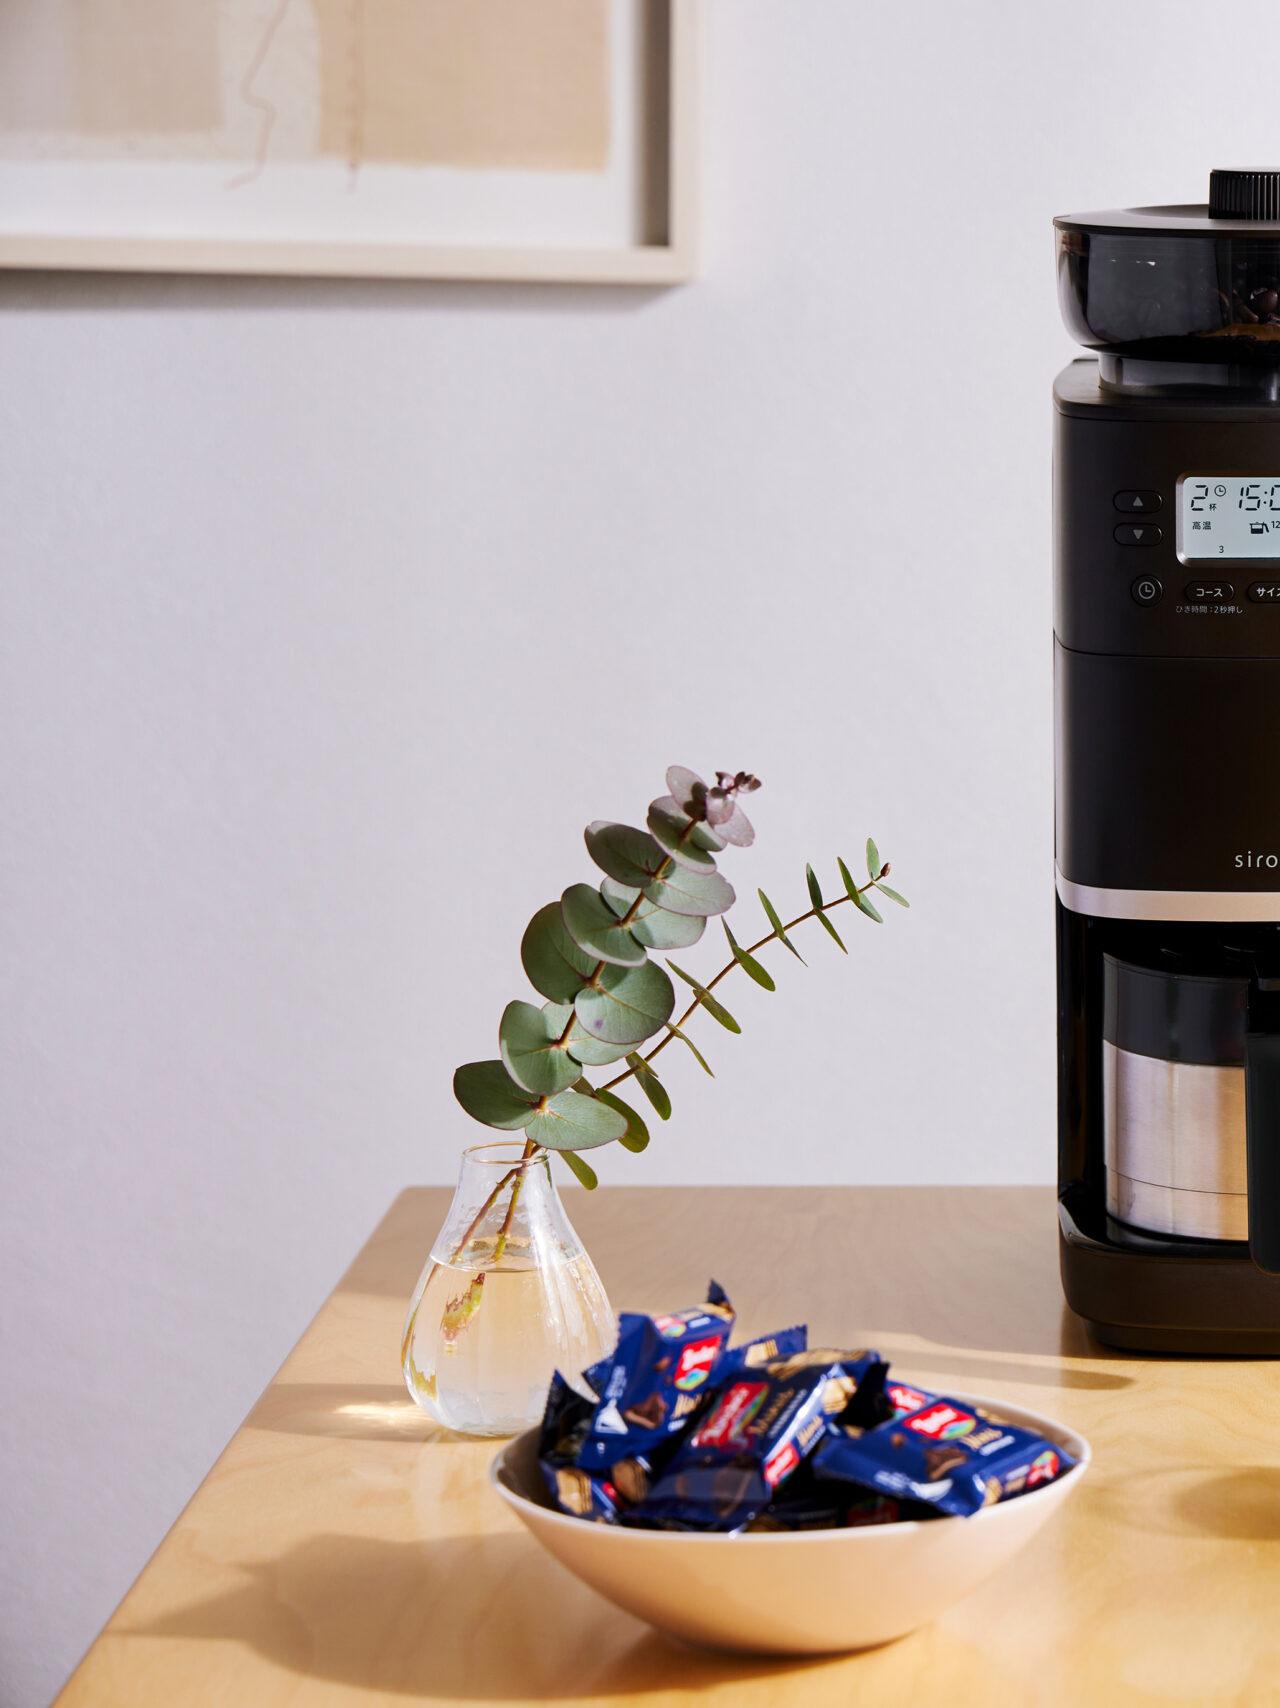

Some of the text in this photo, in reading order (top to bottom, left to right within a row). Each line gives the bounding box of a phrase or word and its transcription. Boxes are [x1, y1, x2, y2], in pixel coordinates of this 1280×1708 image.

[1191, 484, 1209, 511] 2
[1209, 503, 1217, 512] 杯
[1192, 520, 1212, 531] 高温
[1218, 545, 1225, 554] 3
[1195, 587, 1224, 597] コース
